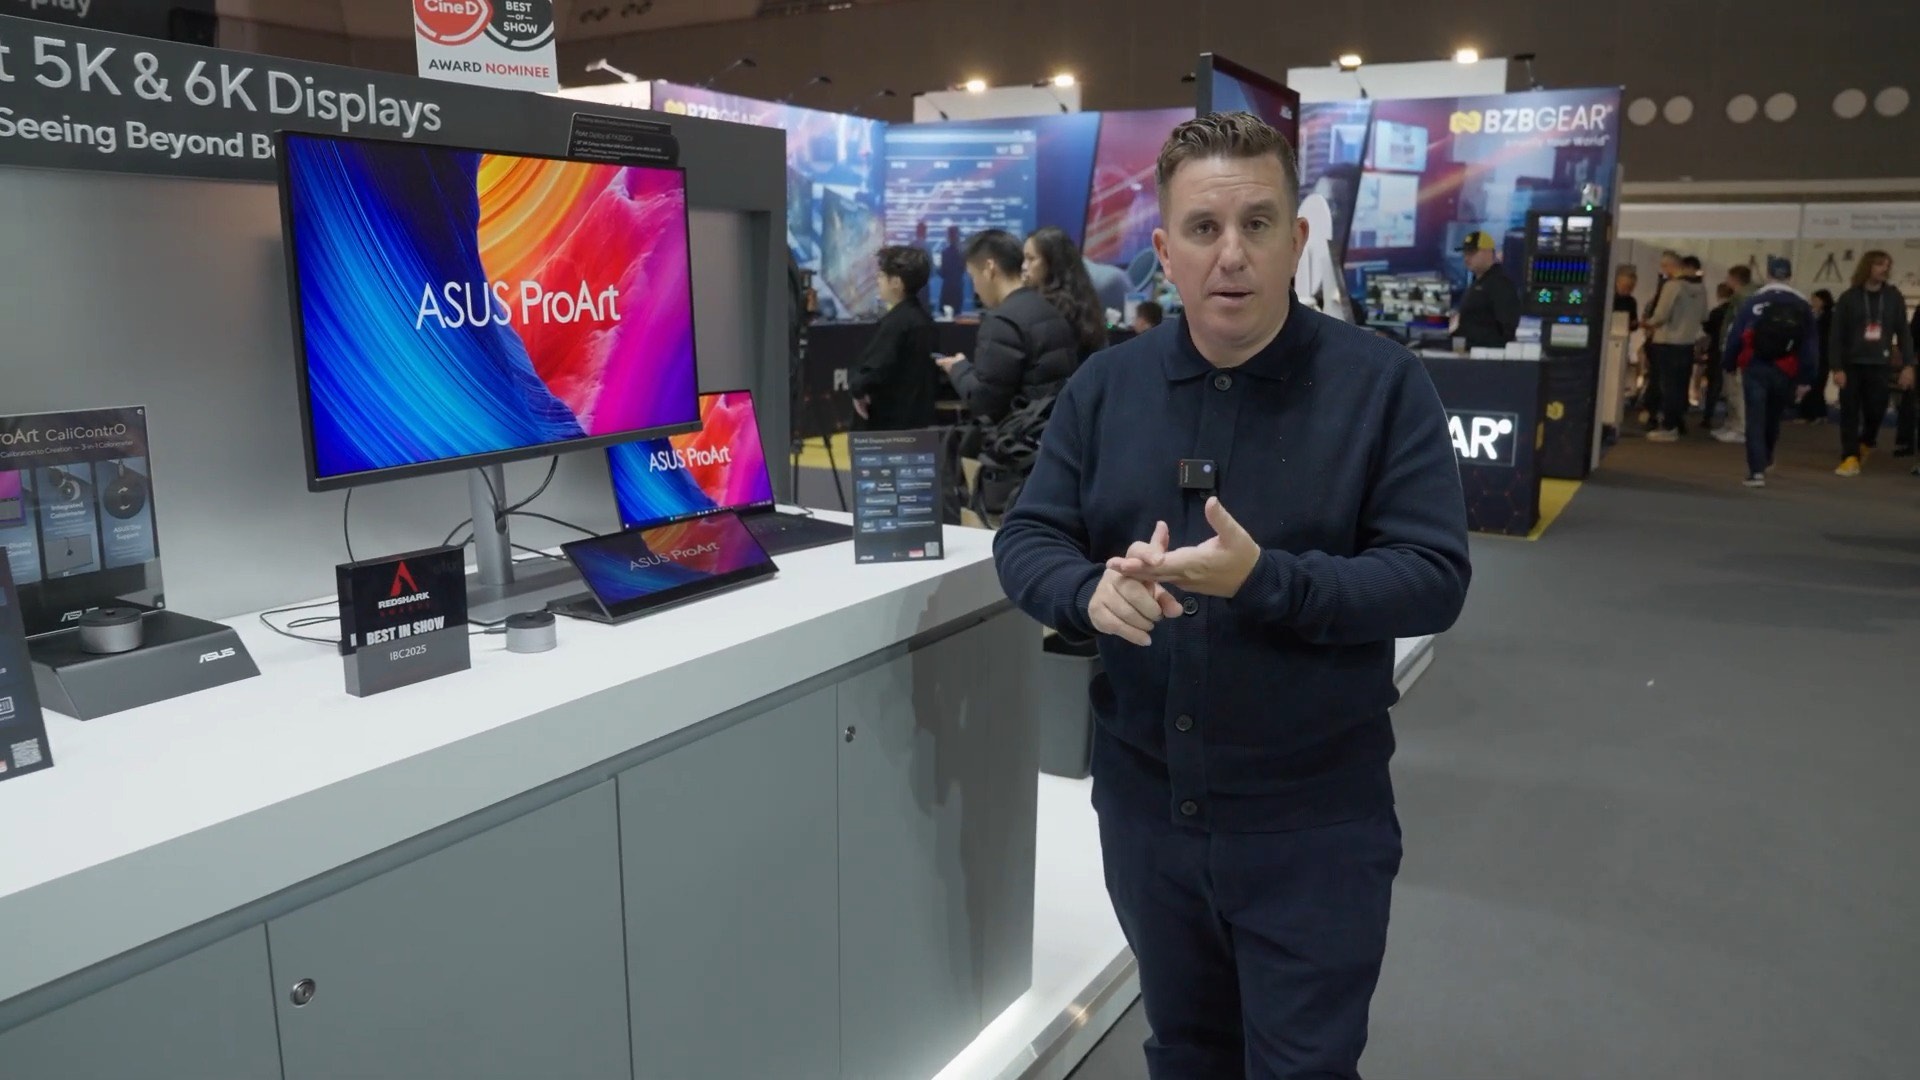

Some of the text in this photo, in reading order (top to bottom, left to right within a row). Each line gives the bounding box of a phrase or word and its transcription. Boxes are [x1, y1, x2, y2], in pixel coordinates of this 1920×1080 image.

[505, 1, 532, 12] BEST
[503, 22, 538, 34] SHOW
[428, 59, 550, 78] AWARD NOMINEE
[34, 36, 122, 95] 5K
[134, 52, 172, 102] &
[185, 61, 257, 112] 6K
[267, 71, 442, 138] Displays
[0, 107, 275, 159] Seeing Beyond B
[415, 280, 621, 329] ASUS ProArt
[46, 423, 126, 441] CaliContrO
[649, 444, 732, 473] ASUS ProArt
[629, 541, 721, 571] ASUS ProArt
[378, 591, 430, 609] REDSHARK
[366, 616, 445, 646] BEST IN SHOW
[199, 647, 236, 664] ASUS
[390, 644, 427, 661] IBC2025
